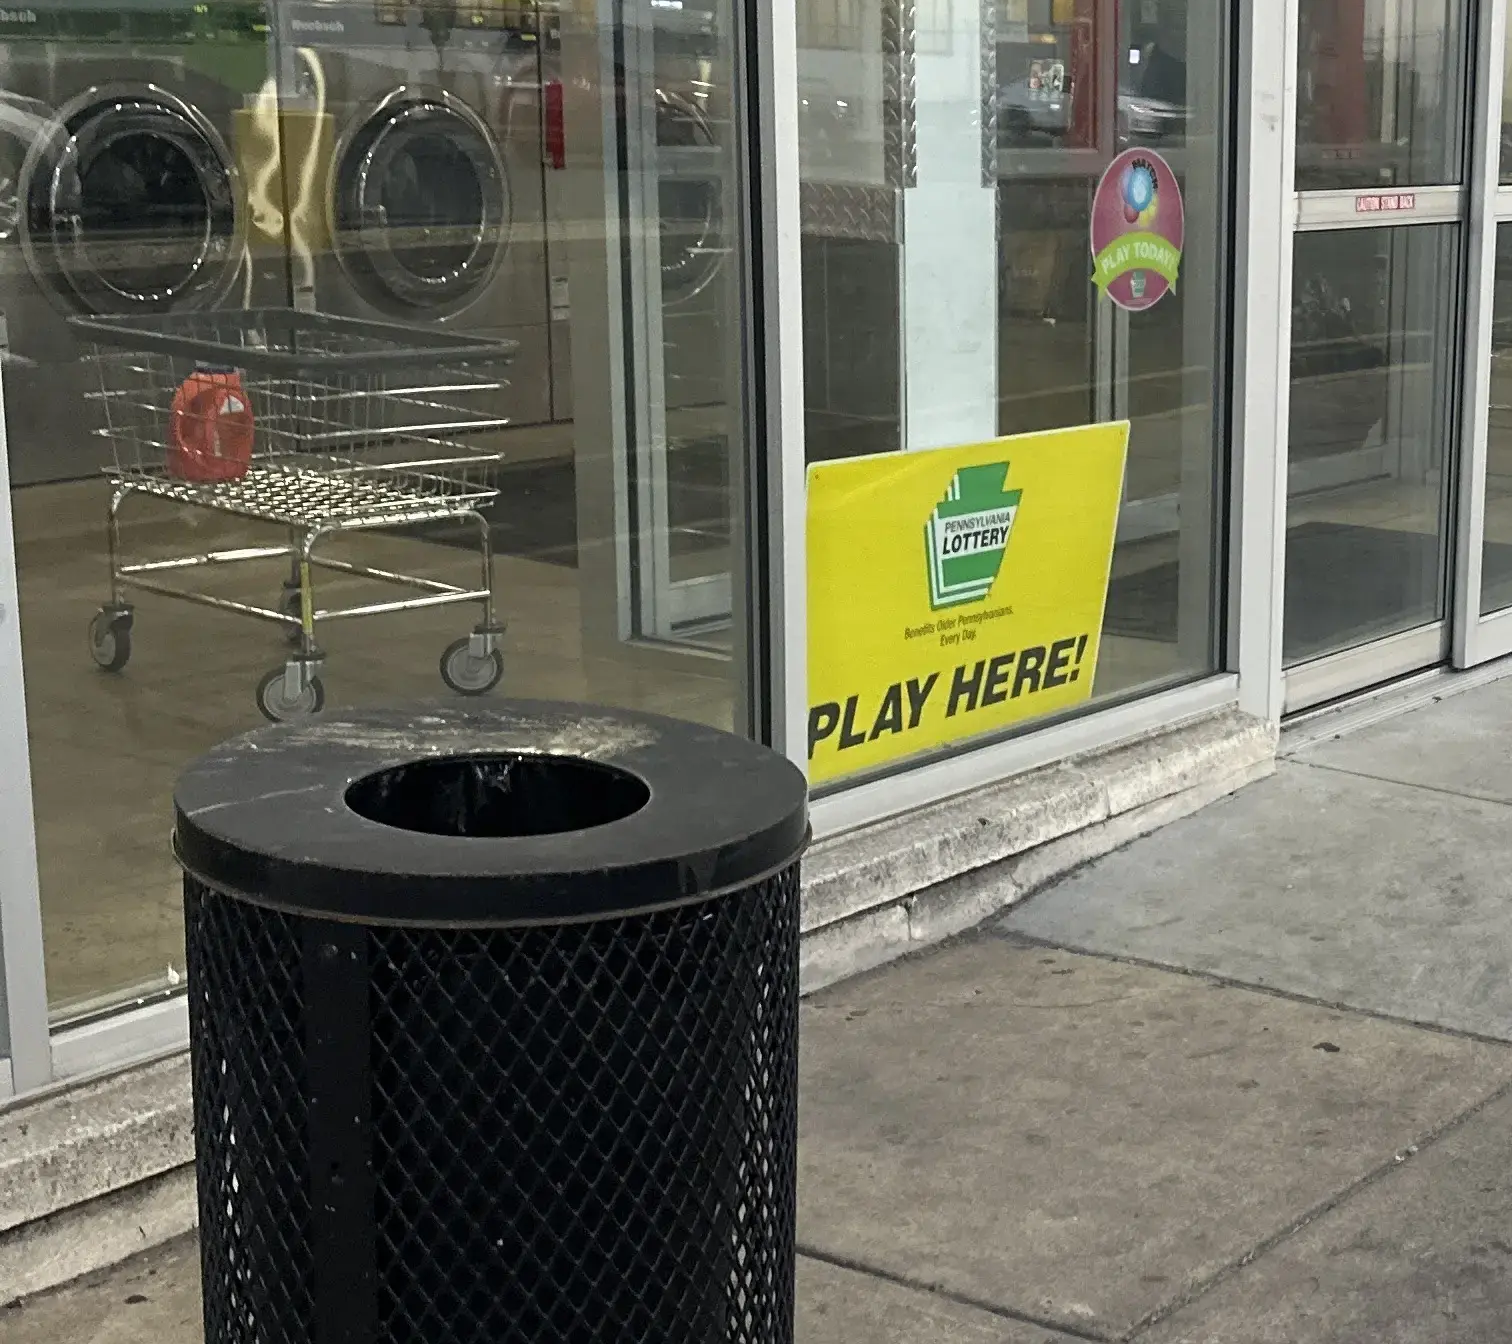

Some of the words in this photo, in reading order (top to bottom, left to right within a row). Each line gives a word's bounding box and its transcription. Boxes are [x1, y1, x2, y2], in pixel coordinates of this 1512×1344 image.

[1101, 243, 1131, 274] PLAY
[944, 511, 1011, 534] PENNSYLVANIA
[942, 525, 1010, 555] LOTTERY
[904, 622, 936, 640] Benefits
[939, 631, 961, 647] Every
[807, 671, 940, 761] PLAY
[944, 634, 1089, 720] HERE!
